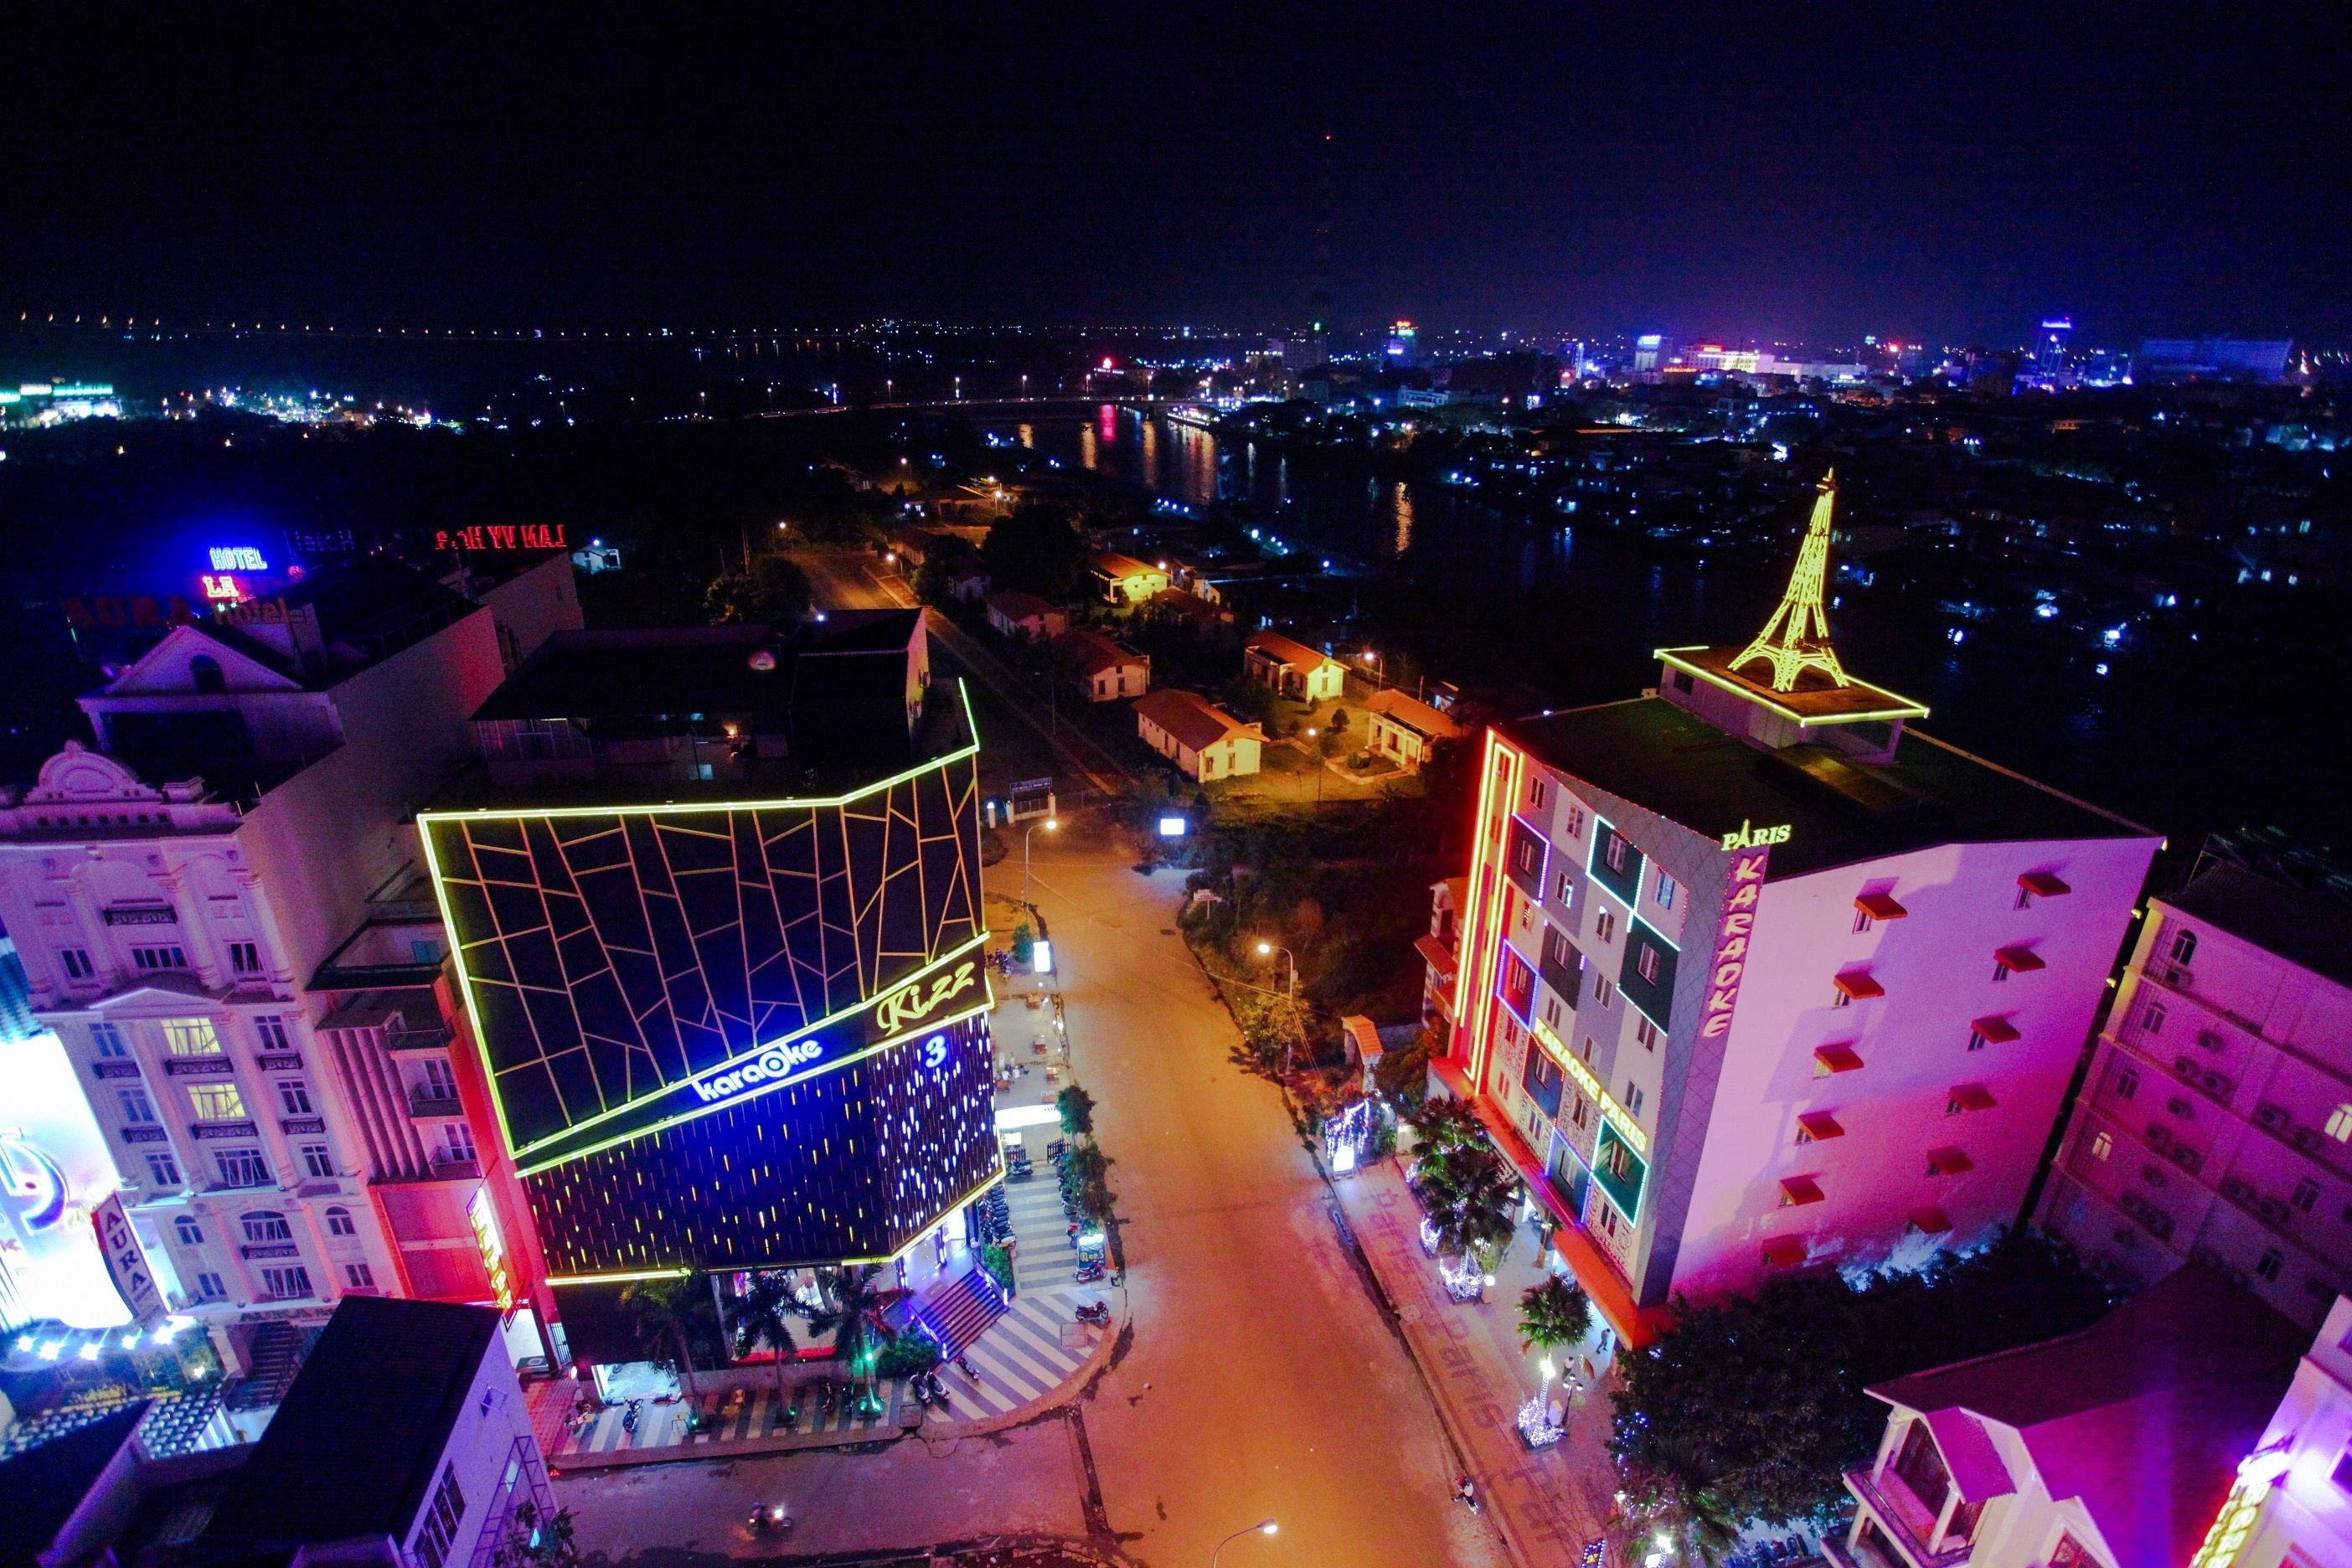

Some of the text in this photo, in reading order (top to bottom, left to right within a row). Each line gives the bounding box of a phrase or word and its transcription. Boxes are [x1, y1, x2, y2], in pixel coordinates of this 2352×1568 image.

[209, 546, 269, 571] HOTEL
[66, 595, 196, 630] AURA
[202, 575, 240, 599] LA
[1721, 819, 1792, 852] PARIS
[1701, 854, 1766, 1039] KARAOKE
[876, 962, 975, 1037] Kizz
[925, 1035, 947, 1069] 3
[1532, 1015, 1649, 1153] KARAOKE PARIS
[106, 1211, 148, 1292] AURA
[1428, 1318, 1508, 1431] Paris
